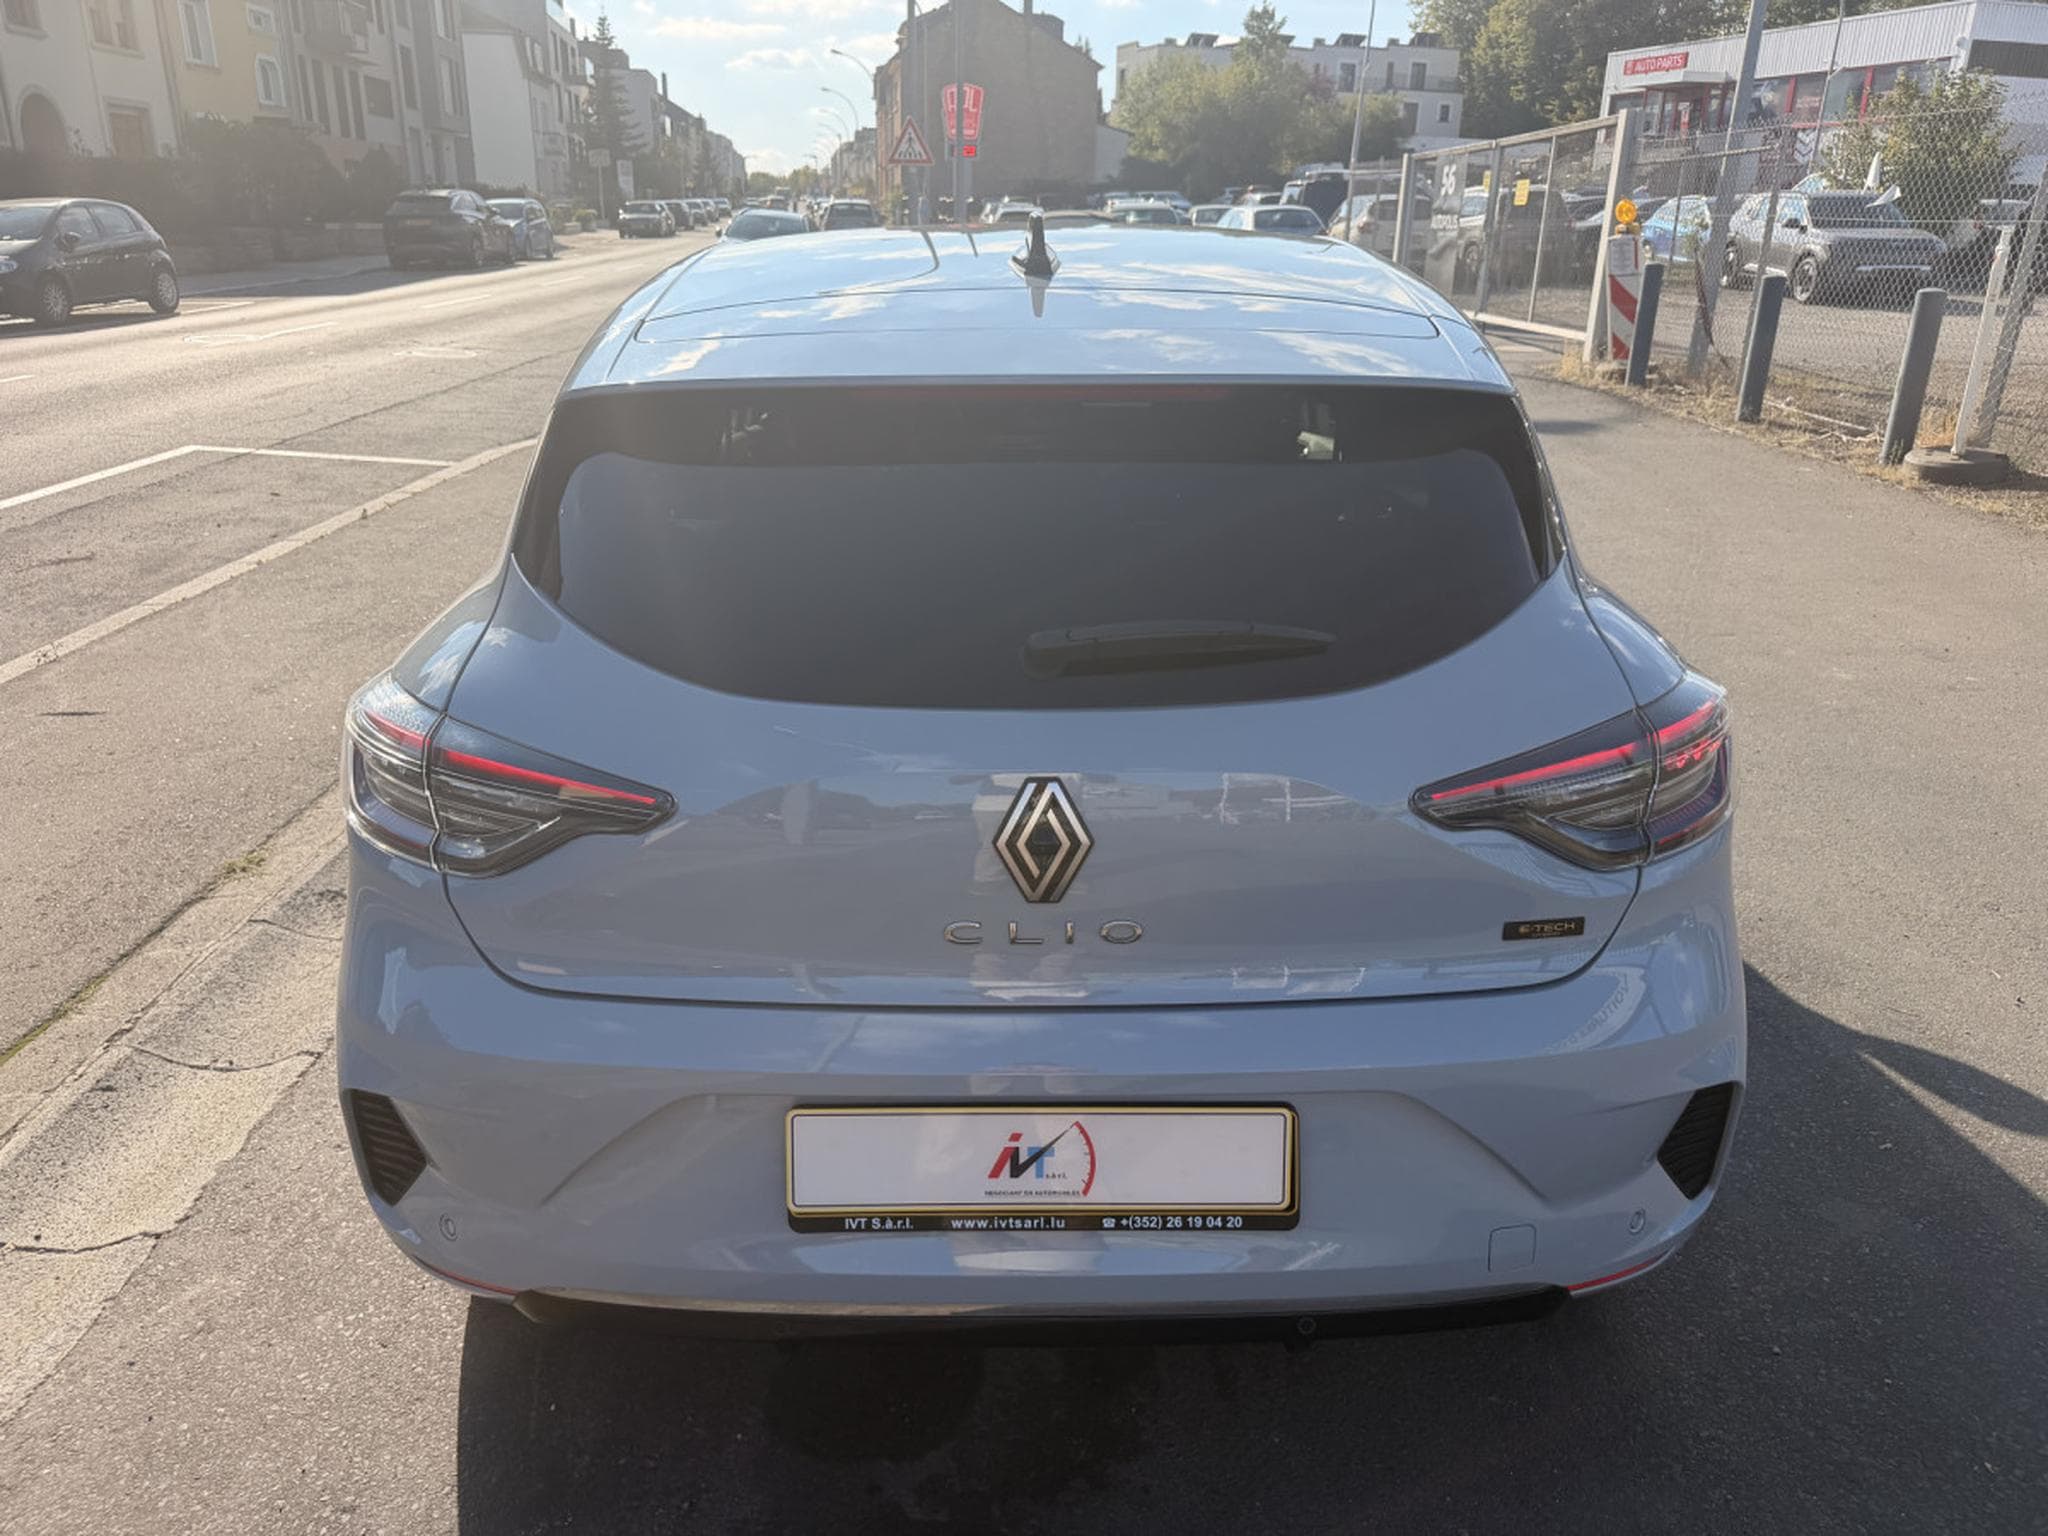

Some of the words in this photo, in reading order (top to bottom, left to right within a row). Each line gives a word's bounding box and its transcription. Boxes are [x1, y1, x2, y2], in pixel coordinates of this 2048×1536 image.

[1634, 59, 1655, 70] AUTO
[1657, 56, 1682, 69] PARTS
[1441, 163, 1457, 196] 56
[943, 920, 1144, 944] CLIO
[845, 1218, 867, 1229] IVT
[872, 1217, 914, 1230] S.à.r.l.
[951, 1217, 1065, 1229] www.ivtsarl.lu
[1166, 1217, 1183, 1229] 26
[1187, 1217, 1203, 1229] 19
[1206, 1217, 1223, 1229] 04
[1226, 1217, 1243, 1229] 20
